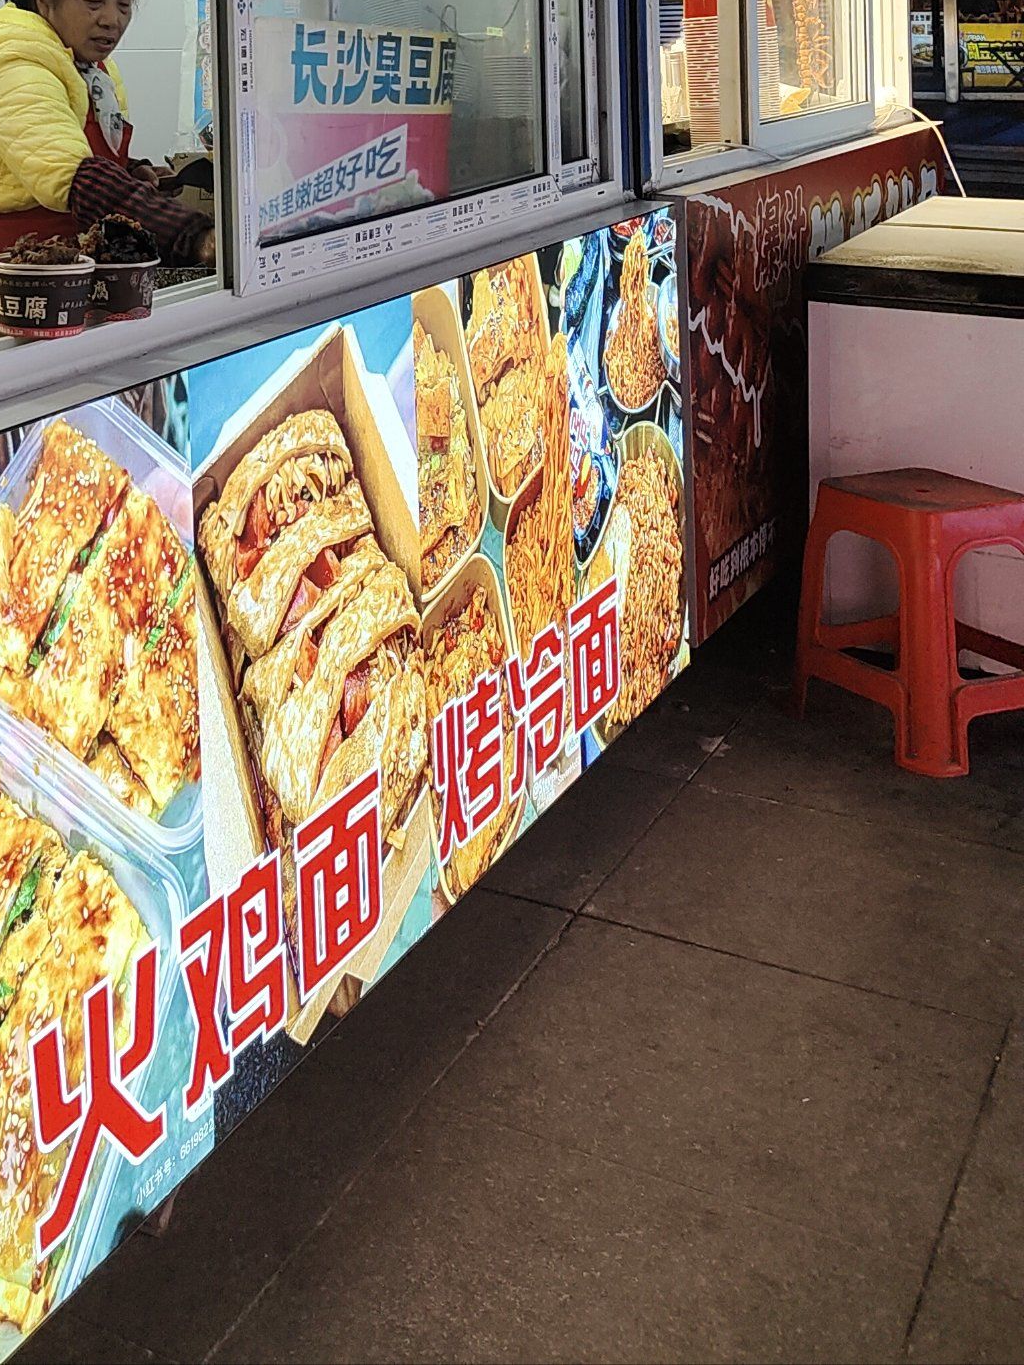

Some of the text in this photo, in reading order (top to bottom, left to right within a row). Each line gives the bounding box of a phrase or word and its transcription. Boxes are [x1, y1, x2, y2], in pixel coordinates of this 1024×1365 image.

[291, 24, 457, 105] 长沙臭豆腐
[259, 135, 402, 226] 外酥里嫩超好吃
[433, 576, 620, 866] 烤冷面
[31, 770, 384, 1260] 火鸡面
